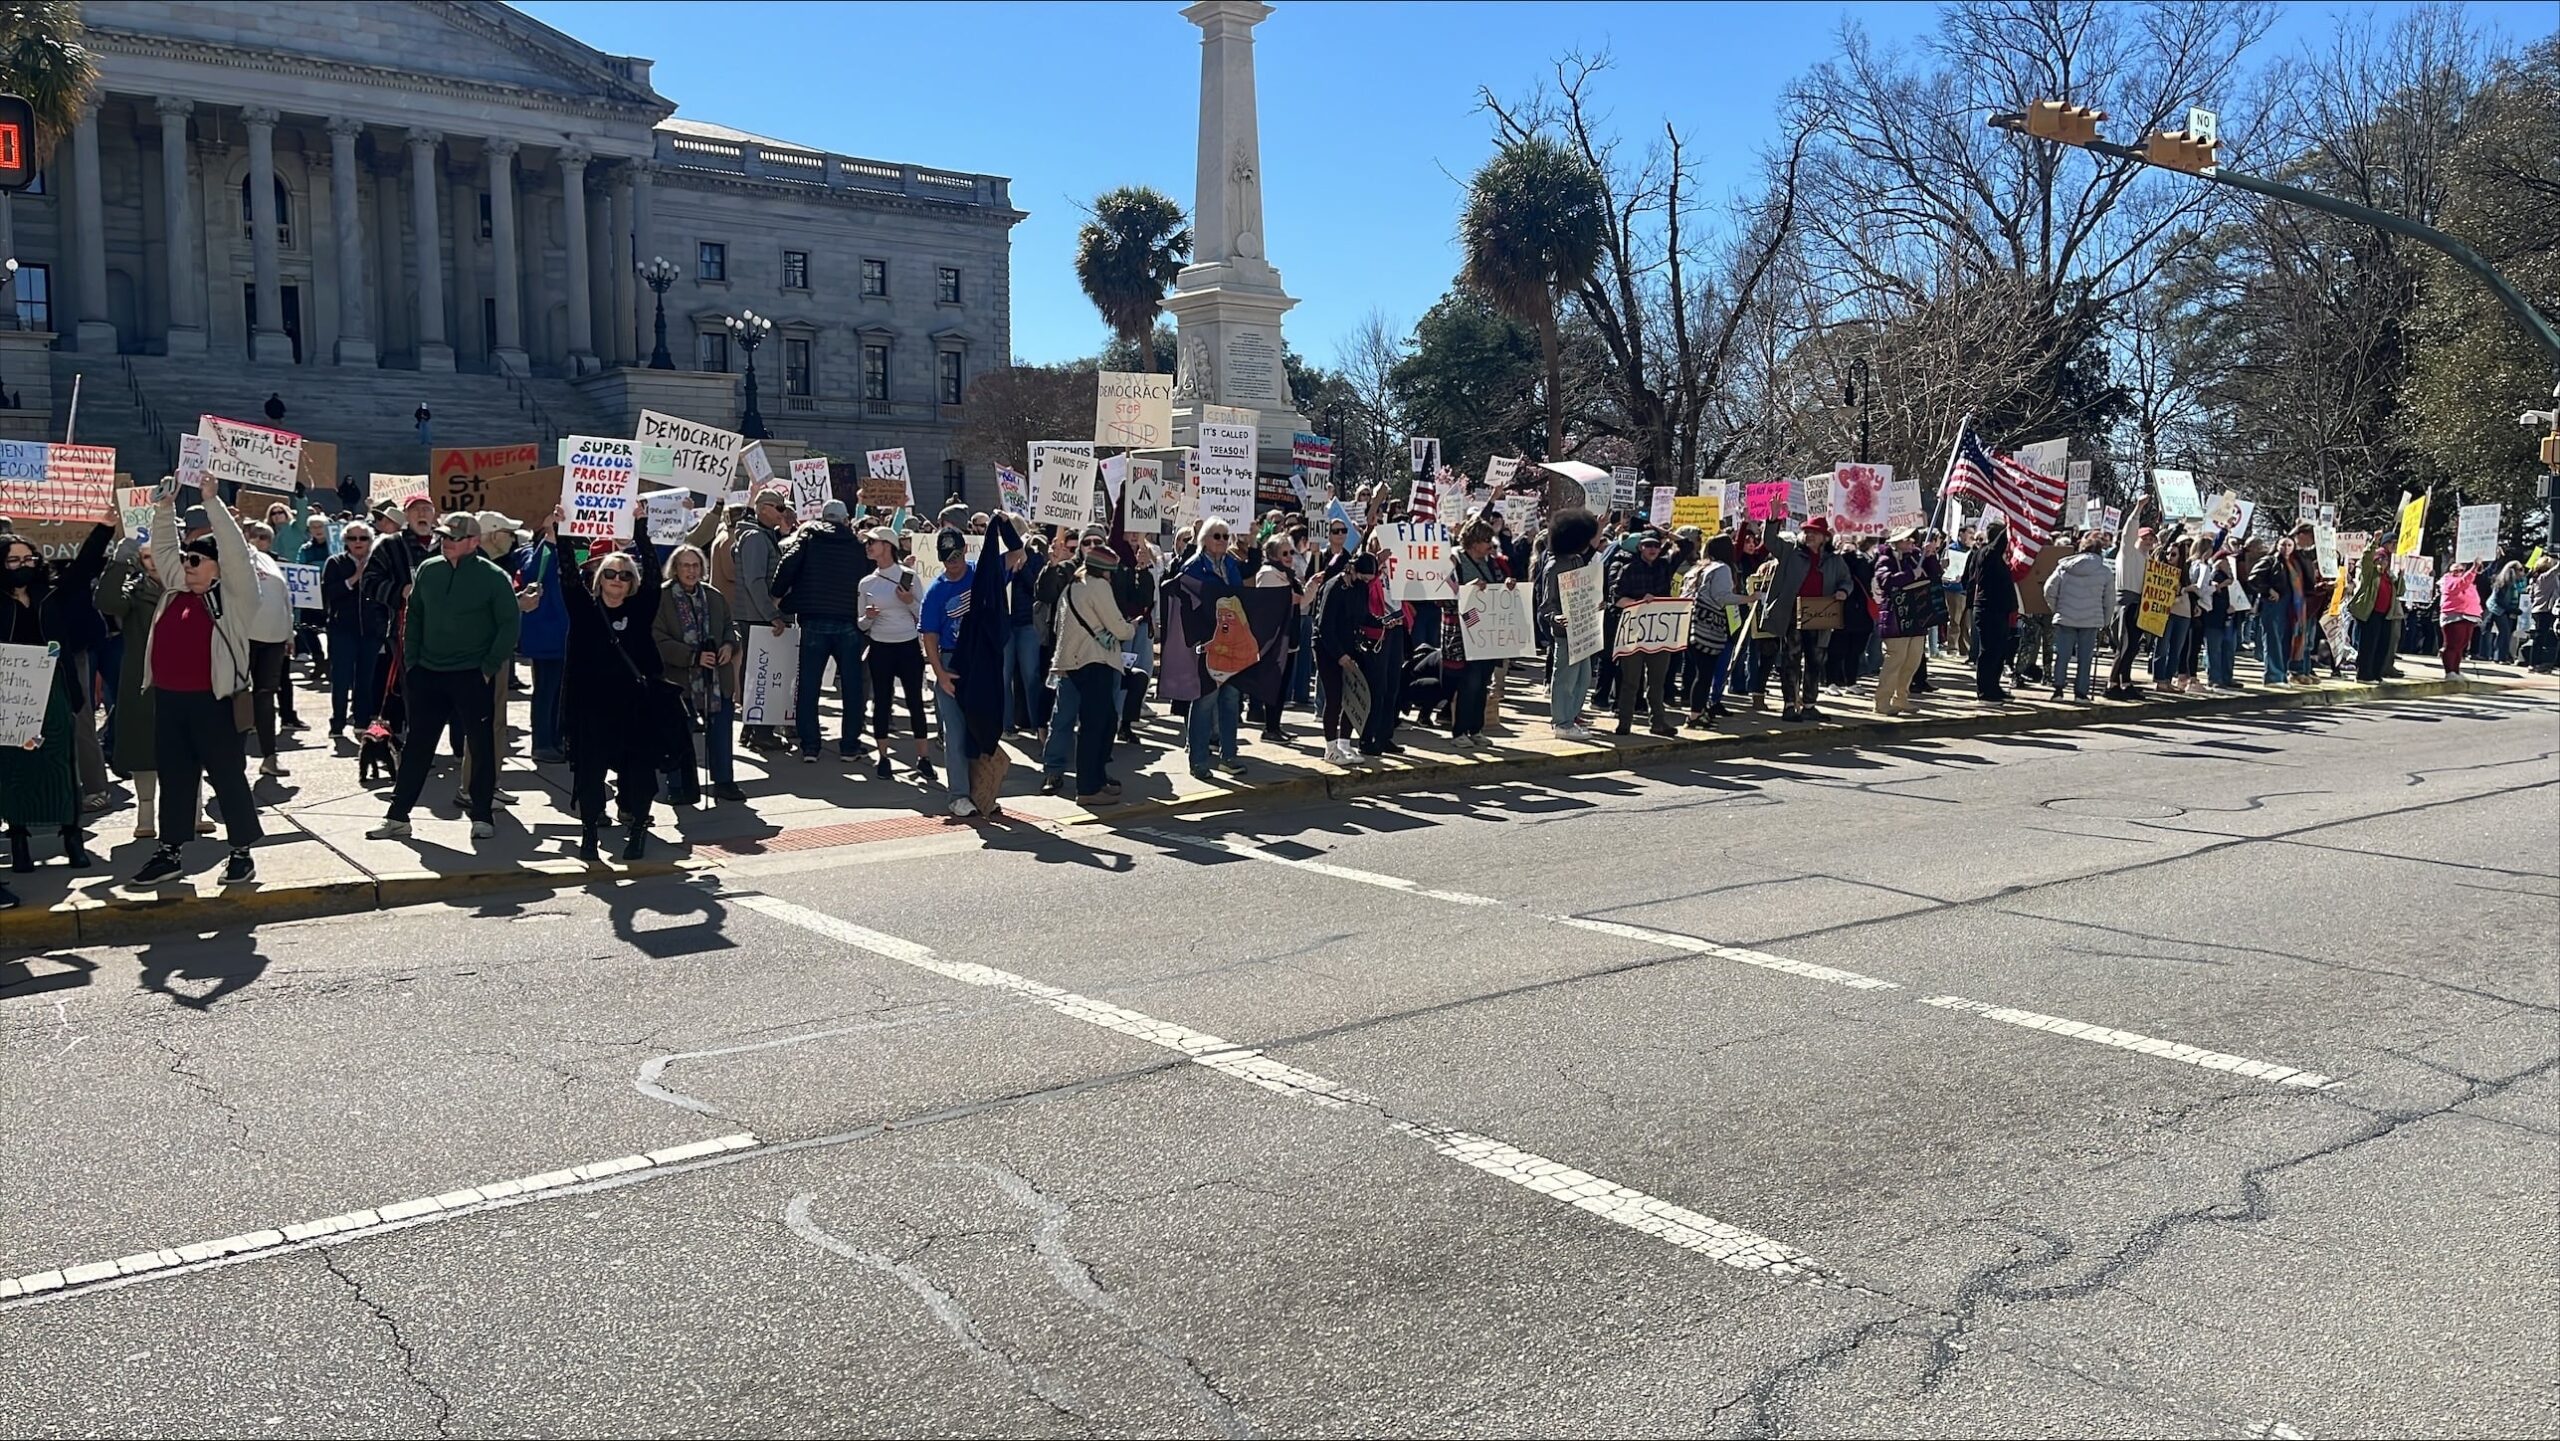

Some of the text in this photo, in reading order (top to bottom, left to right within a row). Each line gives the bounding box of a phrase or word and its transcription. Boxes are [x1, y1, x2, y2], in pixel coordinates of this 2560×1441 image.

[2197, 113, 2210, 128] NO
[1115, 373, 1149, 386] SAVE
[1099, 385, 1171, 400] DEMOCRACY
[1115, 403, 1141, 414] STOP
[274, 433, 297, 449] LOVE
[645, 415, 737, 452] DEMOCRACY
[1106, 422, 1158, 446] COUP
[1203, 428, 1217, 438] IT'S
[1221, 430, 1249, 439] CALLED
[231, 436, 251, 449] NOT
[579, 441, 633, 456] SUPER
[36, 446, 114, 465] TYRANNY
[1209, 445, 1249, 458] TREASON!
[571, 453, 633, 468] CALLOUS
[1053, 455, 1089, 471] HANDS OFF
[71, 467, 106, 483] LAW
[572, 467, 631, 483] FRAGILE
[1132, 466, 1158, 486] BELONGS
[1201, 466, 1221, 476] LOCK
[372, 479, 397, 491] SAVE
[575, 481, 625, 496] RACIST
[1059, 473, 1079, 491] MY
[1052, 491, 1079, 506] SOCIAL
[1201, 486, 1228, 496] EXPELL
[1230, 487, 1252, 497] MUSK
[574, 495, 626, 510] SEXIST
[1131, 499, 1158, 519] PRISON
[1210, 505, 1240, 513] IMPEACH
[52, 502, 93, 519] DUTY
[576, 509, 614, 523] NAZI
[1044, 505, 1083, 522] SECURITY
[570, 521, 615, 535] POTUS
[1309, 519, 1329, 540] HATE
[1397, 521, 1449, 542] FIRE
[42, 543, 79, 560] DAY
[1408, 545, 1439, 560] THE
[2147, 559, 2181, 577] IMPEACH
[2153, 574, 2174, 587] TRUMP
[1476, 589, 1520, 613] STOP
[2143, 585, 2172, 603] ARREST
[1488, 612, 1516, 626] THE
[1616, 611, 1689, 647] RESIST
[747, 648, 769, 722] DEMOCRACY
[772, 672, 782, 688] IS
